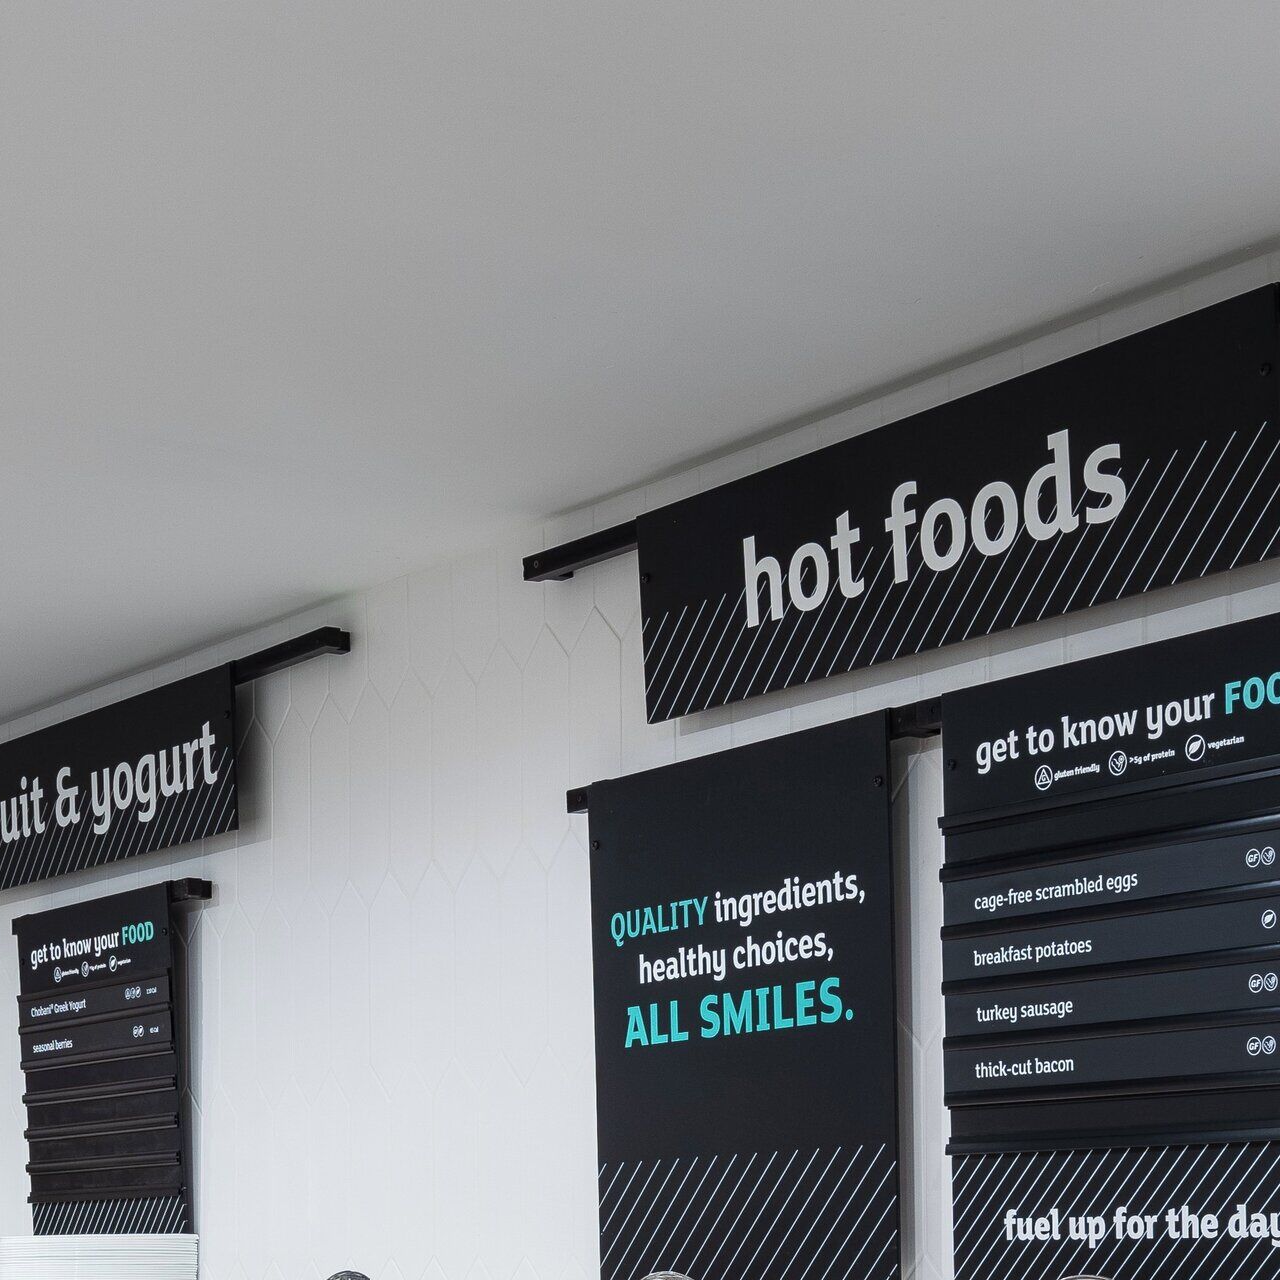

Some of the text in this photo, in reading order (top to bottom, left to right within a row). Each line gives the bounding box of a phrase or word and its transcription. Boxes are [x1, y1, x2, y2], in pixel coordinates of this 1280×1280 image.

[742, 428, 1128, 629] hot foods
[976, 730, 1019, 774] get
[1026, 724, 1055, 755] to
[1061, 708, 1138, 749] know
[1146, 692, 1215, 740] your
[1208, 735, 1245, 750] vegetarian
[1054, 763, 1100, 781] gluten friendly
[1143, 754, 1150, 762] of
[1151, 749, 1175, 762] protein
[55, 766, 81, 828] &
[90, 720, 218, 835] yogurt
[610, 870, 866, 947] QUALITY ingredients,
[974, 872, 1138, 911] cage-free scrambled eggs
[30, 921, 154, 970] get to know your FOOD
[638, 930, 834, 985] healthy choices,
[973, 938, 1092, 966] breakfast potatoes
[54, 1001, 69, 1014] Greek
[69, 998, 87, 1012] Yogurt
[624, 976, 854, 1049] ALL SMILES.
[976, 999, 1073, 1023] turkey sausage
[32, 1038, 73, 1053] seasonal berries
[975, 1057, 1074, 1079] thick-cut bacon
[1003, 1208, 1061, 1242] fuel
[1069, 1215, 1106, 1249] up
[1113, 1206, 1159, 1240] for
[1165, 1205, 1219, 1240] the
